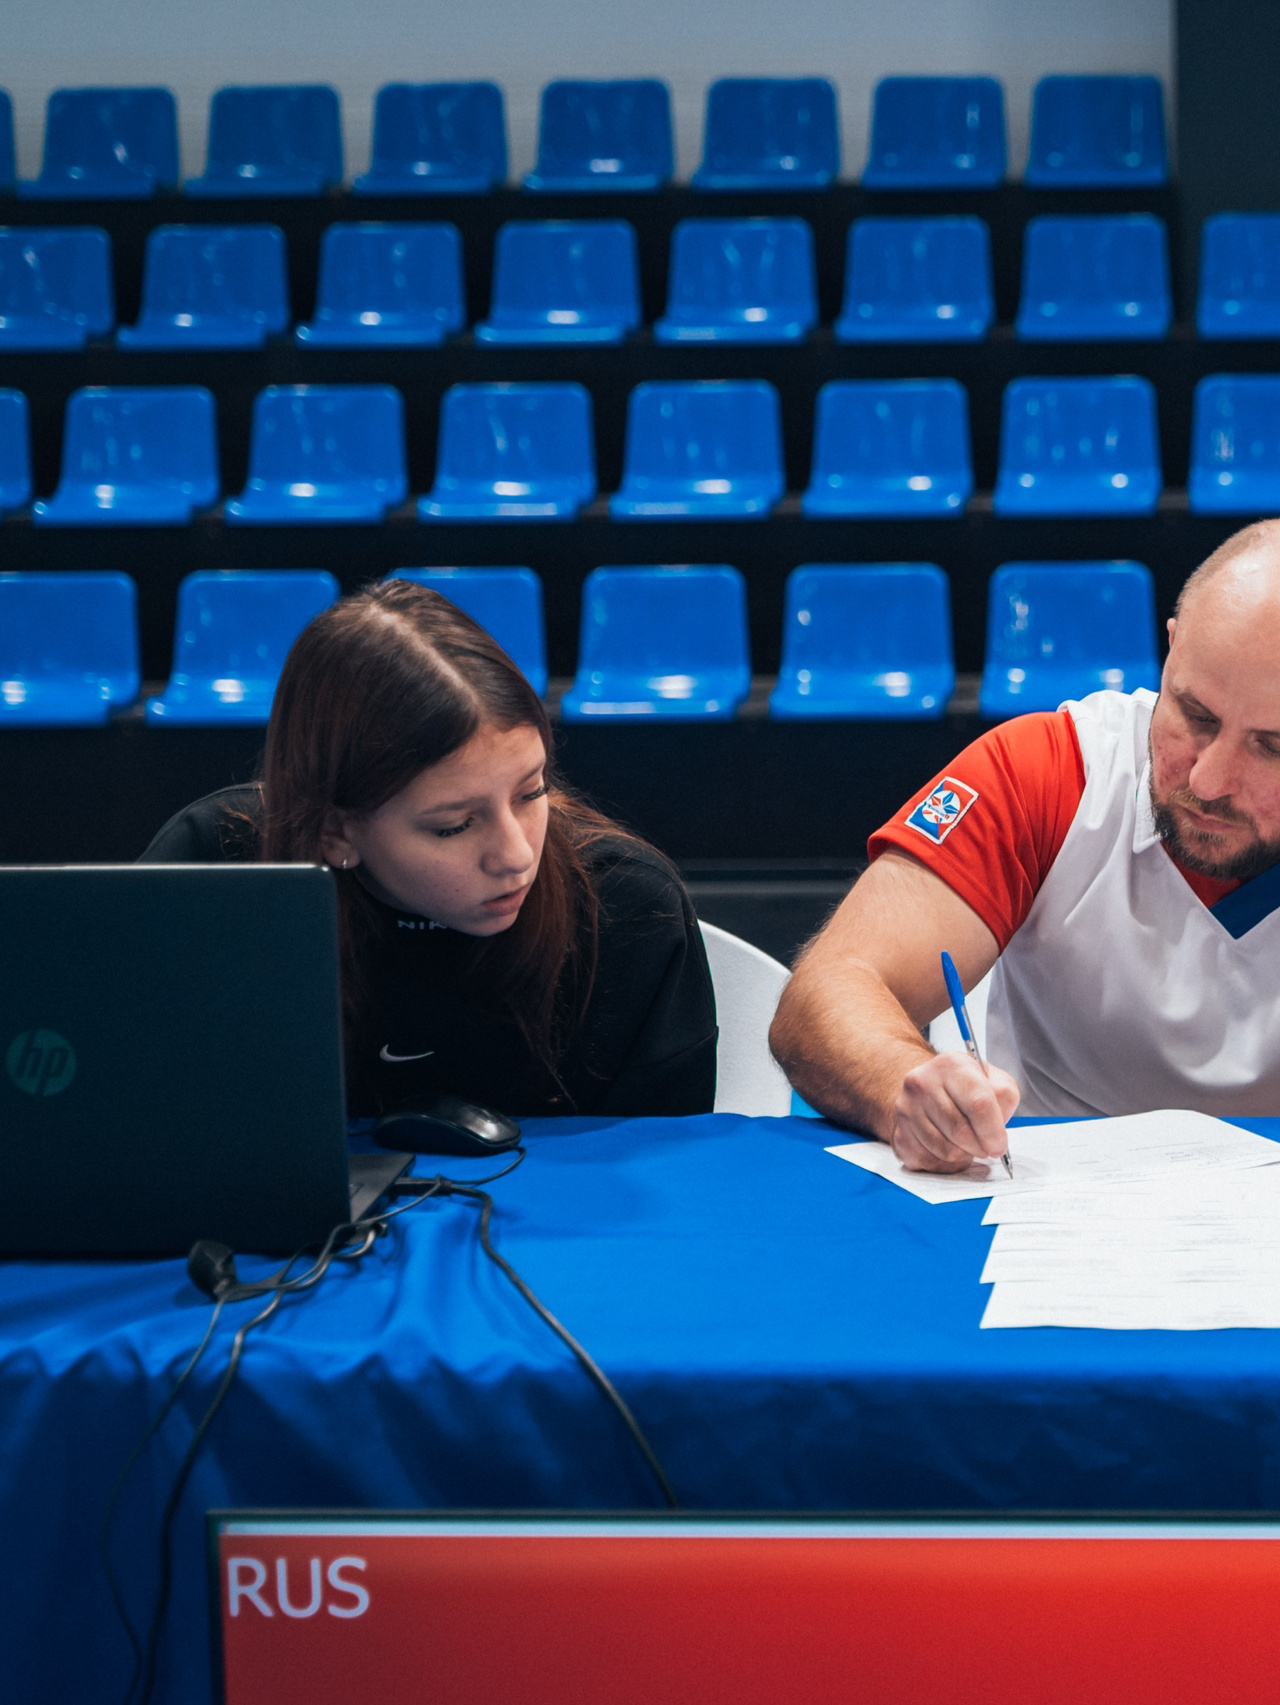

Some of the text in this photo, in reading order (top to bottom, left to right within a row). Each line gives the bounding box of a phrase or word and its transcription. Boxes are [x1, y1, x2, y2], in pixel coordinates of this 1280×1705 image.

[398, 920, 448, 930] NIK
[15, 1028, 71, 1097] hp
[227, 1556, 370, 1619] RUS
